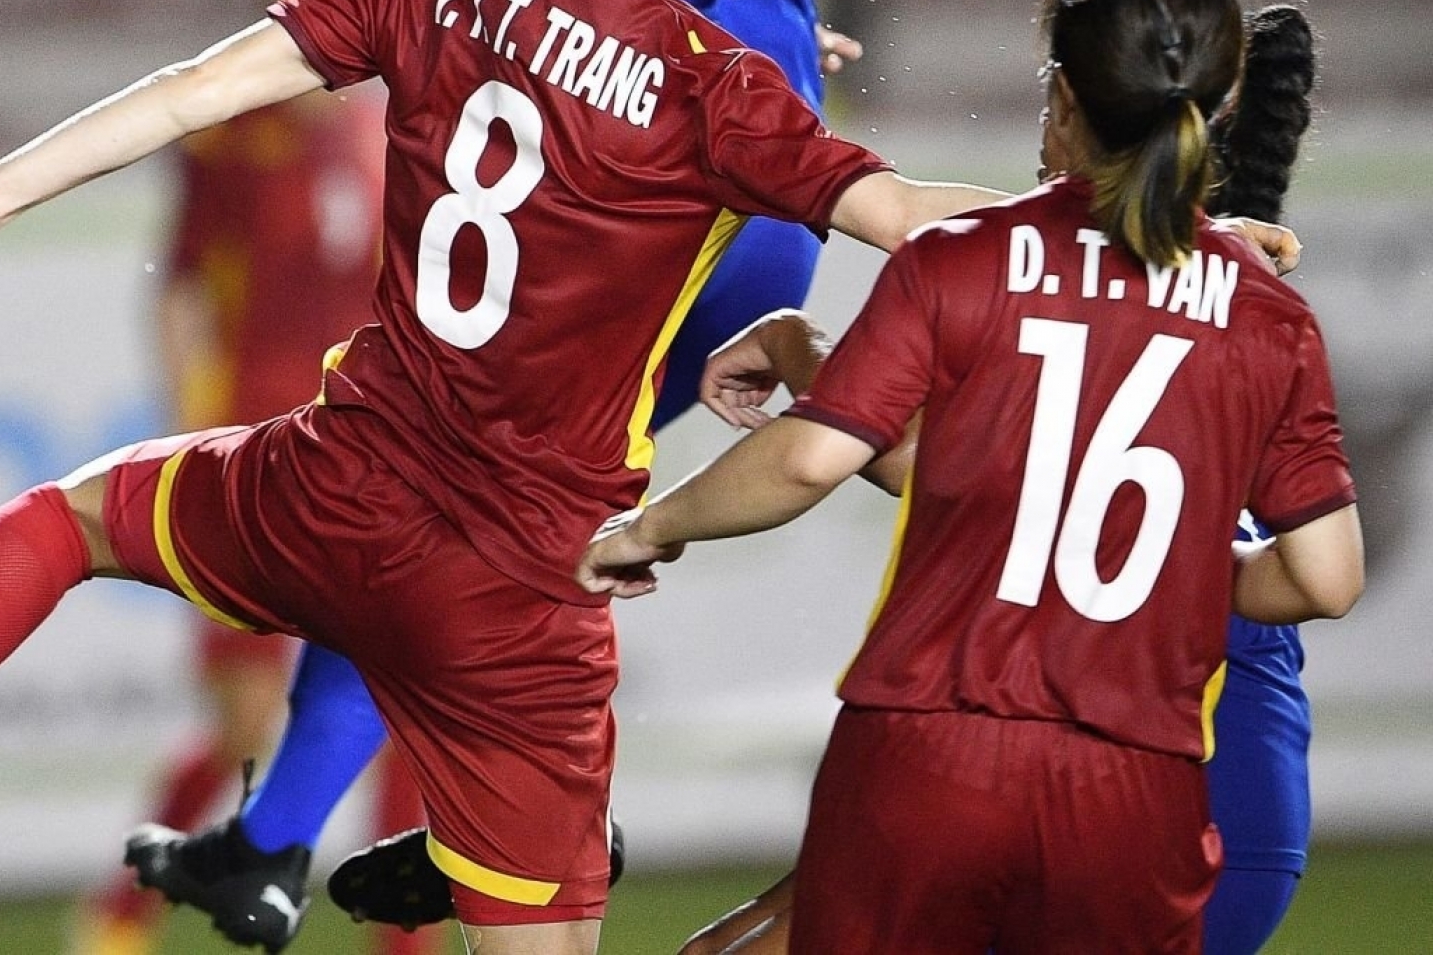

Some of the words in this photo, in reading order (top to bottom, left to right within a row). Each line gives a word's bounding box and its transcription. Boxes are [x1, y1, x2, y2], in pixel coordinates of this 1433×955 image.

[529, 6, 665, 128] TRANG
[416, 80, 545, 349] 8
[1007, 225, 1060, 295] D.
[1076, 229, 1126, 299] T.
[1146, 250, 1240, 329] VAN
[996, 318, 1195, 623] 16
